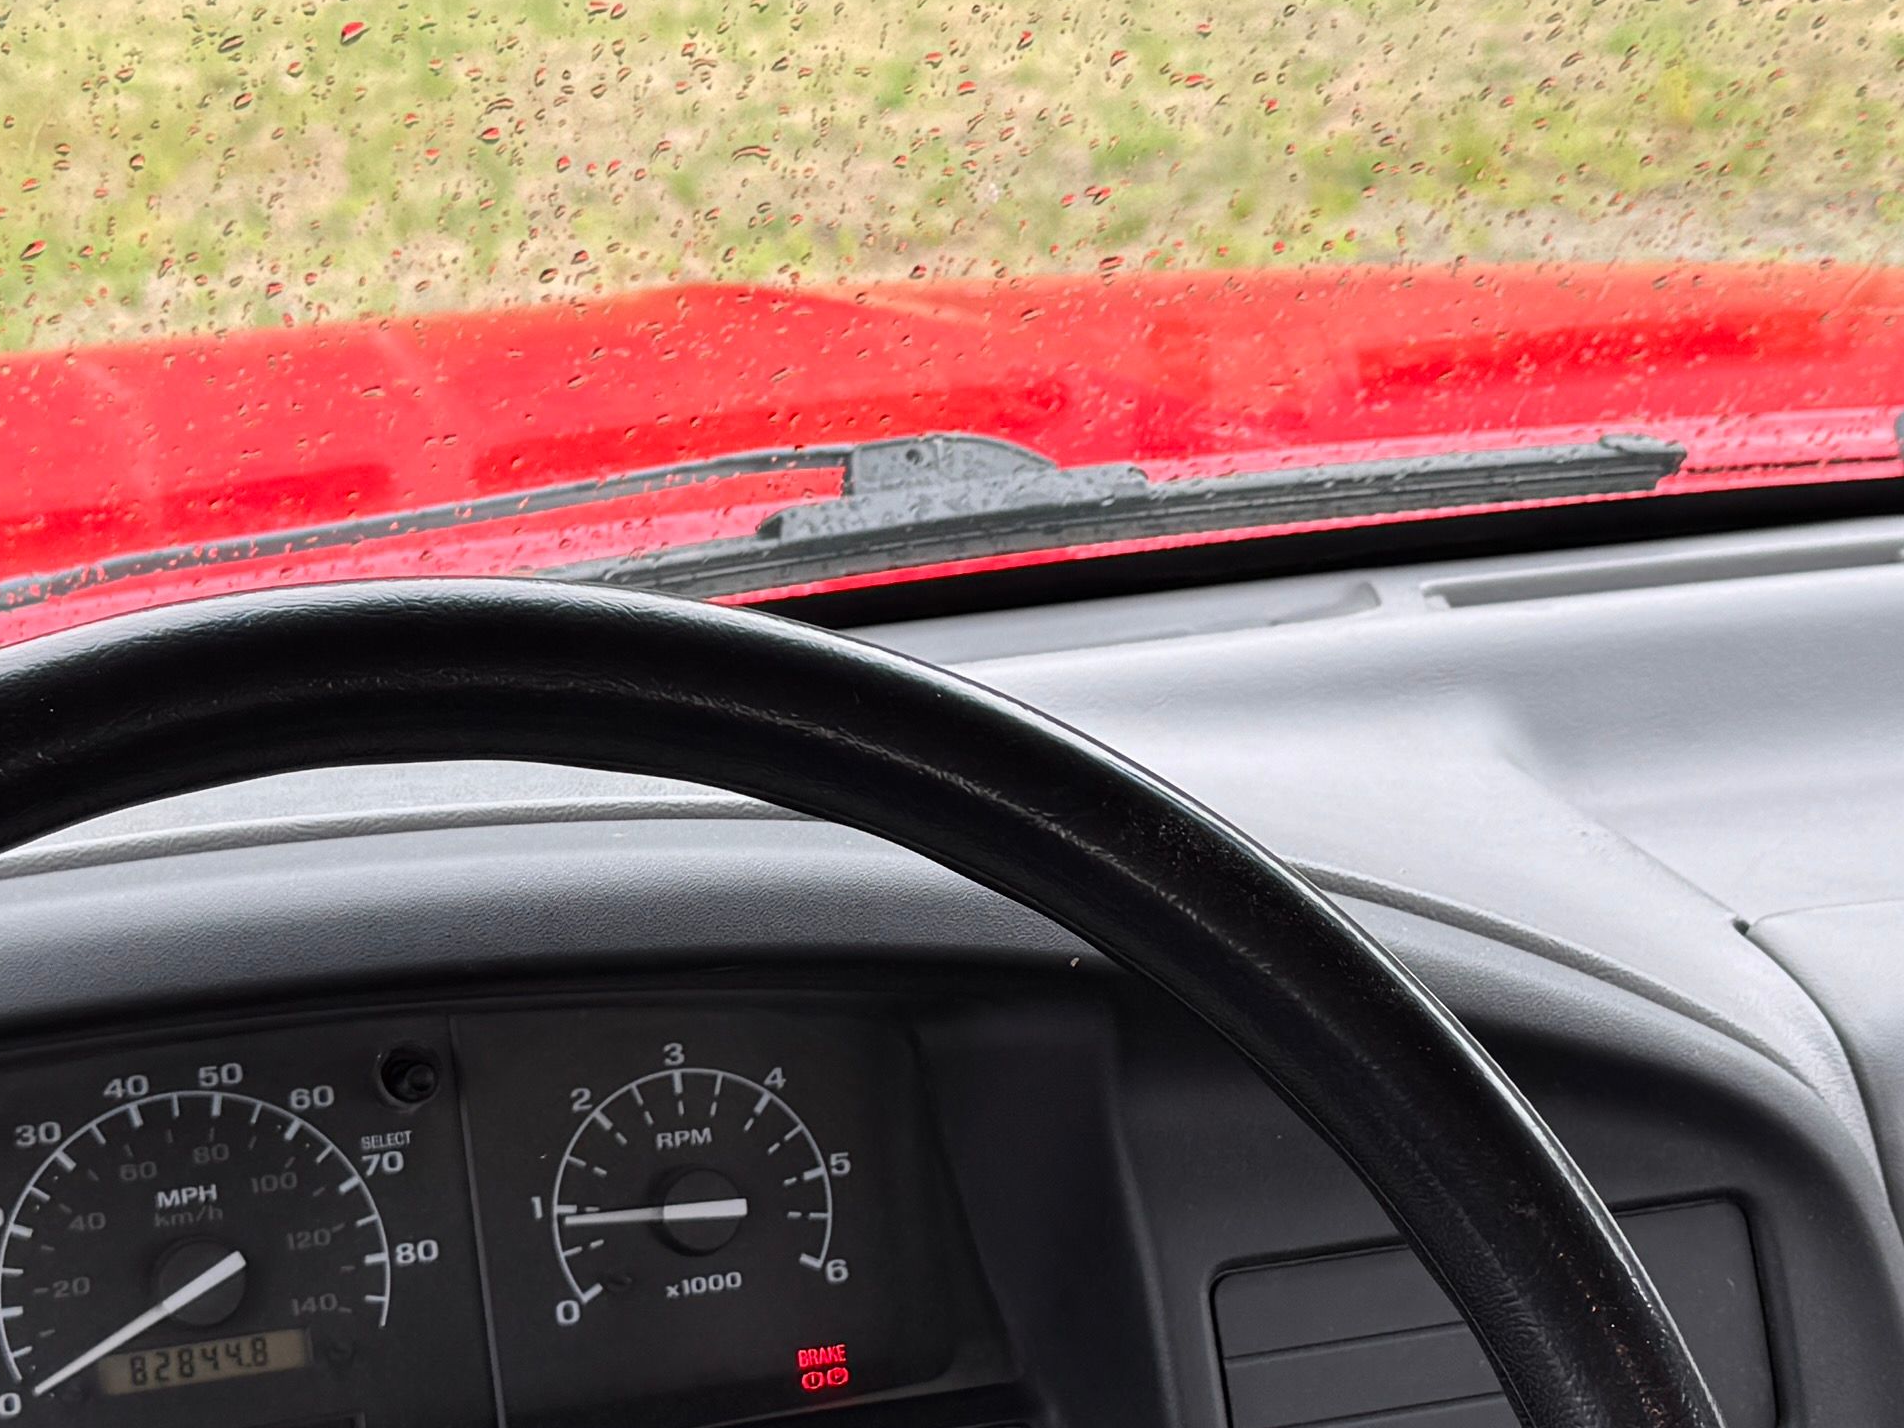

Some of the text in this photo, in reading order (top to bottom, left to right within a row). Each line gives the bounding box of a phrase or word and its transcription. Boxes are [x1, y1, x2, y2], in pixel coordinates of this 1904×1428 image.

[664, 1043, 685, 1066] 3
[104, 1074, 150, 1099] 40
[198, 1062, 243, 1087] 50
[764, 1067, 787, 1089] 4
[290, 1085, 334, 1110] 60
[571, 1088, 592, 1112] 2
[15, 1121, 62, 1147] 30
[361, 1130, 412, 1150] SELECT
[656, 1127, 712, 1151] RPM
[193, 1143, 229, 1163] 80
[361, 1151, 404, 1176] 70
[829, 1152, 851, 1175] 5
[251, 1173, 297, 1193] 100
[156, 1184, 217, 1208] MPH
[530, 1196, 543, 1219] 1
[68, 1212, 106, 1231] 40
[154, 1205, 224, 1228] km/h
[287, 1229, 332, 1251] 120
[395, 1239, 439, 1266] 80
[825, 1259, 849, 1284] 6
[53, 1277, 90, 1298] 20
[665, 1271, 743, 1299] x1000
[291, 1293, 338, 1316] 140
[555, 1299, 581, 1326] 0
[798, 1344, 846, 1368] BRAKE
